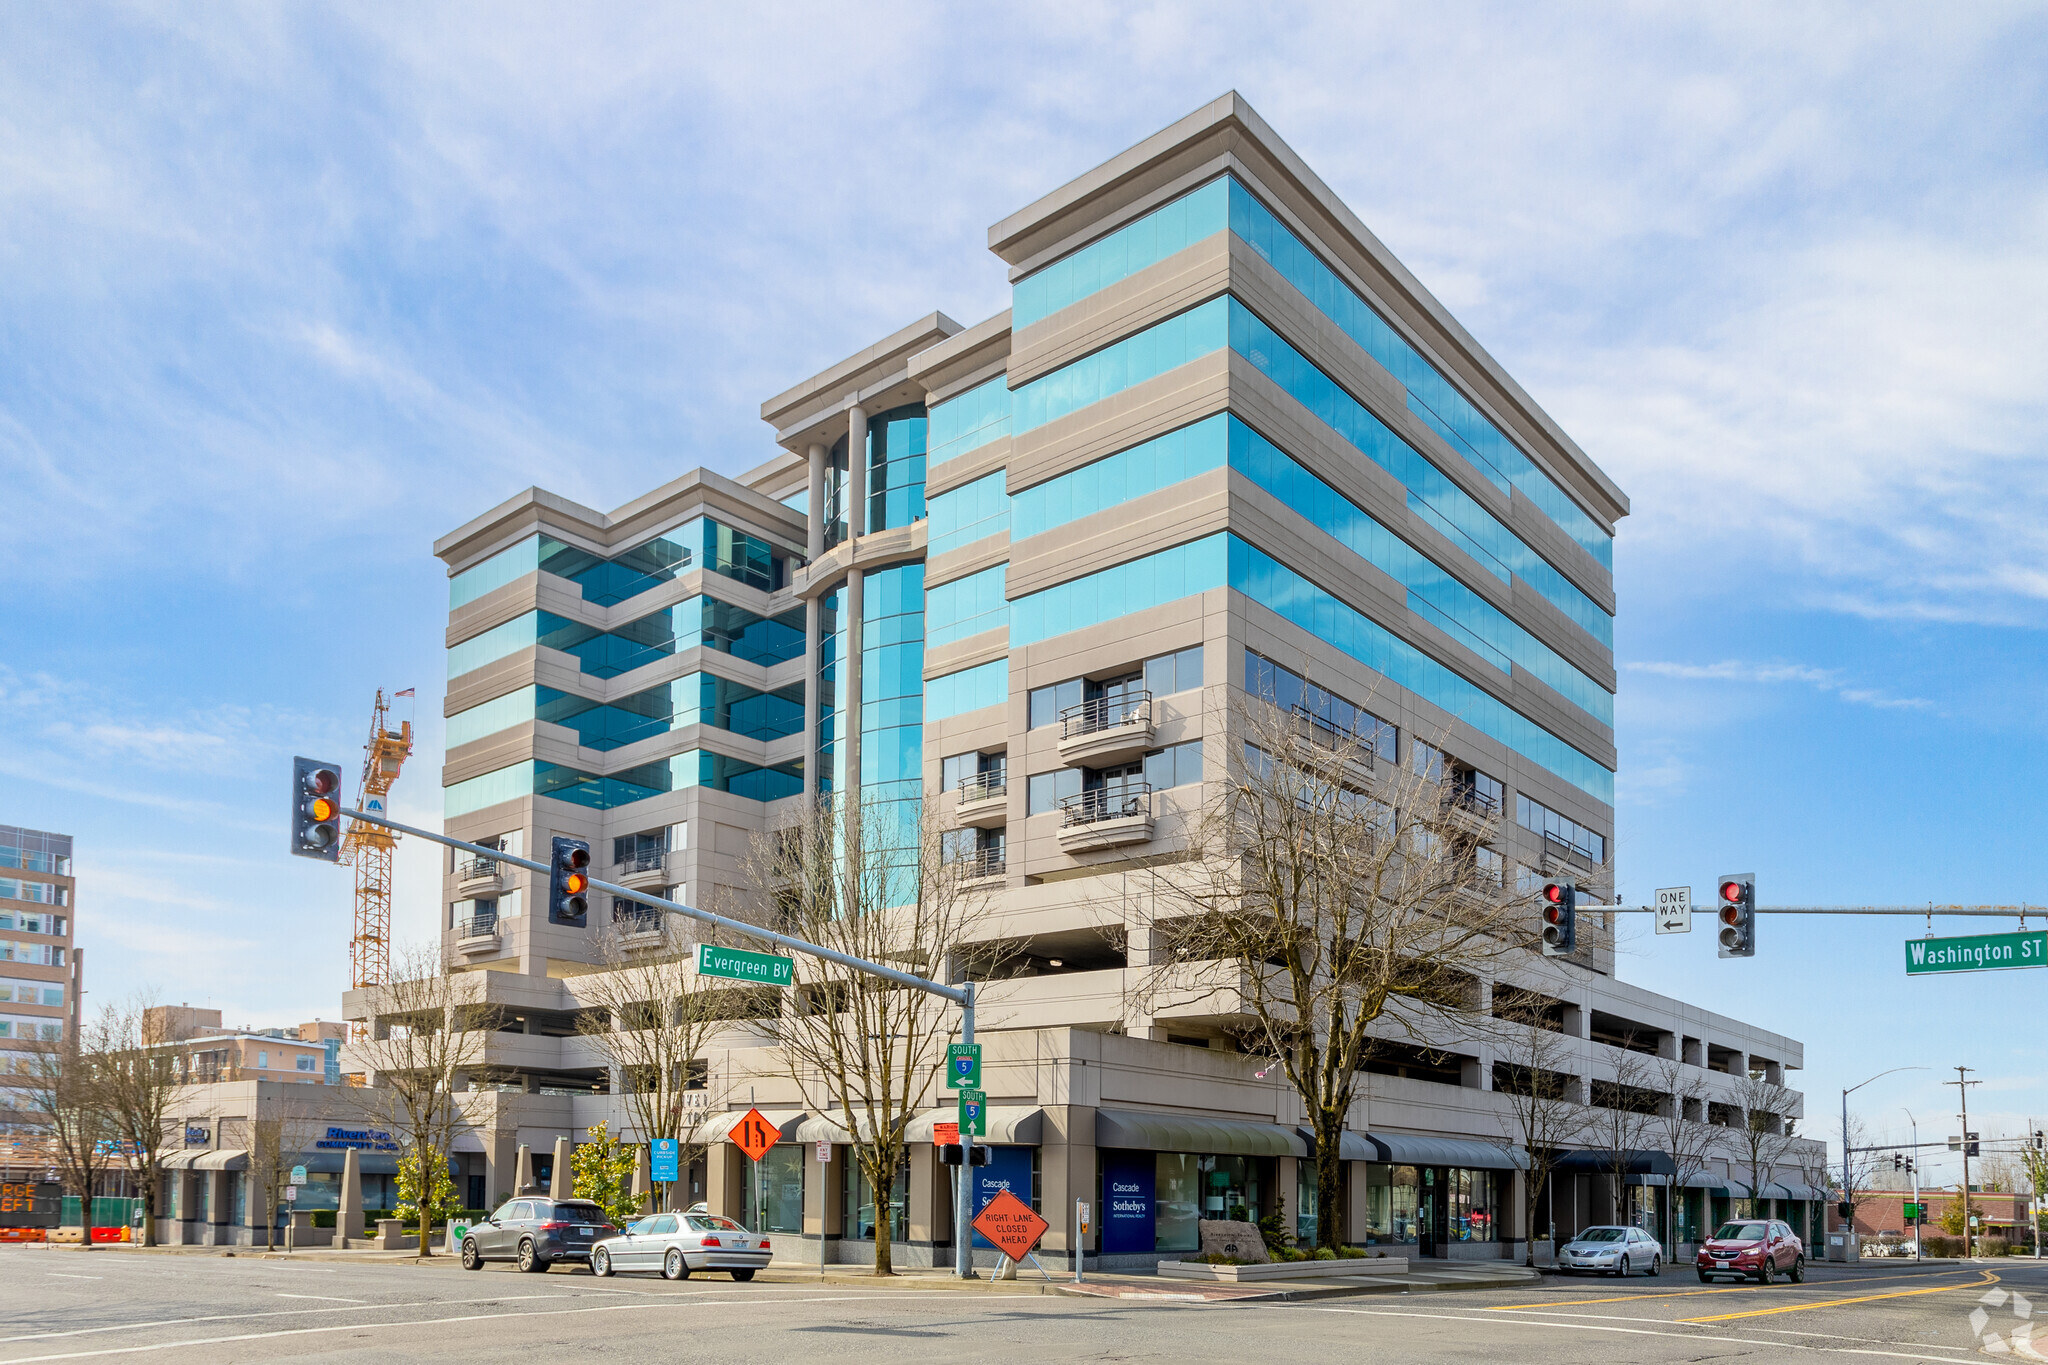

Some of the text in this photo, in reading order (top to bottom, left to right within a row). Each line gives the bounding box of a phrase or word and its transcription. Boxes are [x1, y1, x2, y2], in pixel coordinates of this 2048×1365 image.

[1660, 892, 1685, 903] ONE
[1660, 904, 1686, 915] WAY
[1910, 939, 2042, 966] Washington ST
[703, 948, 790, 979] Evergreen BV
[952, 1046, 977, 1054] SOUTH
[962, 1062, 967, 1071] 5
[963, 1091, 983, 1100] SOUTH
[326, 1127, 390, 1140] Riverview
[316, 1140, 372, 1149] COMMUNITY
[982, 1178, 1010, 1188] Cascade
[1113, 1182, 1139, 1192] Cascade
[1113, 1200, 1146, 1213] Sotheby's
[986, 1213, 1033, 1222] RIGHT LANE
[996, 1224, 1027, 1233] CLOSED
[1001, 1235, 1027, 1244] AHEAD
